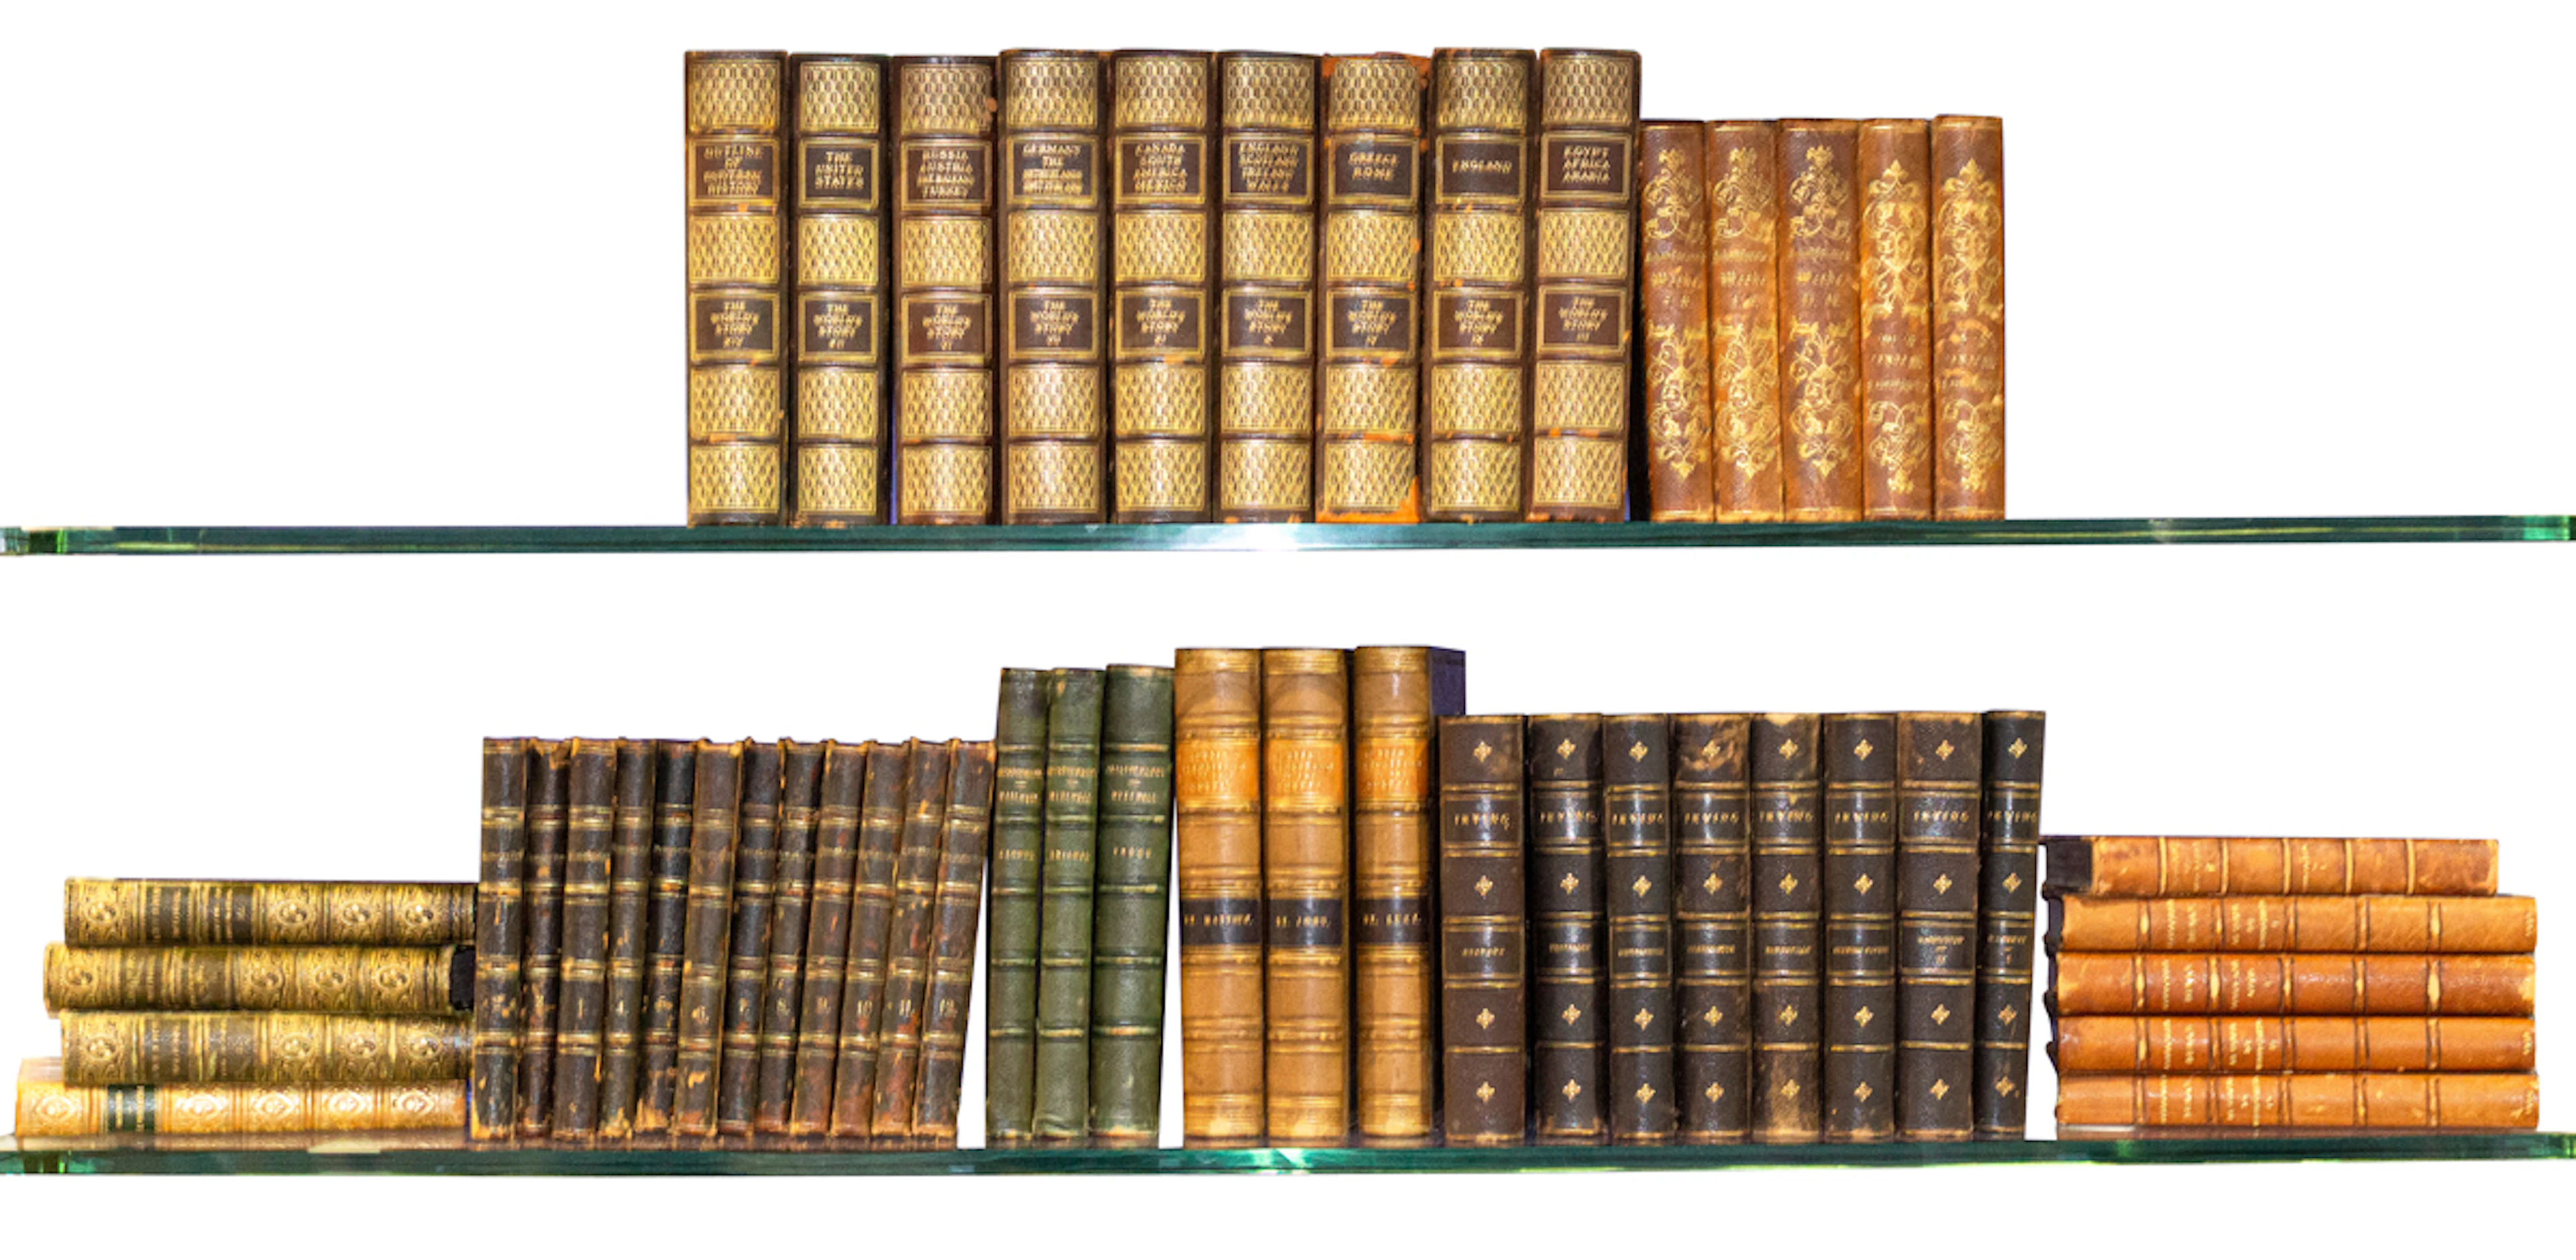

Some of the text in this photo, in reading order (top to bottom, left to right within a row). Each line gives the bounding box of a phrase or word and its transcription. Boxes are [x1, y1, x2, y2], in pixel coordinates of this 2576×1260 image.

[1023, 143, 1081, 156] GERMANY
[1135, 143, 1185, 156] CANADA
[1239, 142, 1298, 155] ENGLAND
[1564, 145, 1609, 158] EGYPT
[825, 151, 853, 163] THE
[1140, 155, 1181, 167] SOUTH
[1348, 152, 1399, 166] GREECE
[814, 164, 864, 176] UNITED
[1452, 159, 1511, 173] ENGLAND
[1563, 158, 1610, 170] AFRICA
[1133, 168, 1187, 180] AMERICA
[1352, 167, 1393, 180] ROME
[1562, 170, 1610, 183] ARABIA
[814, 176, 864, 189] STATES
[1134, 180, 1186, 193] MEXICO
[1913, 810, 1970, 824] IRVING
